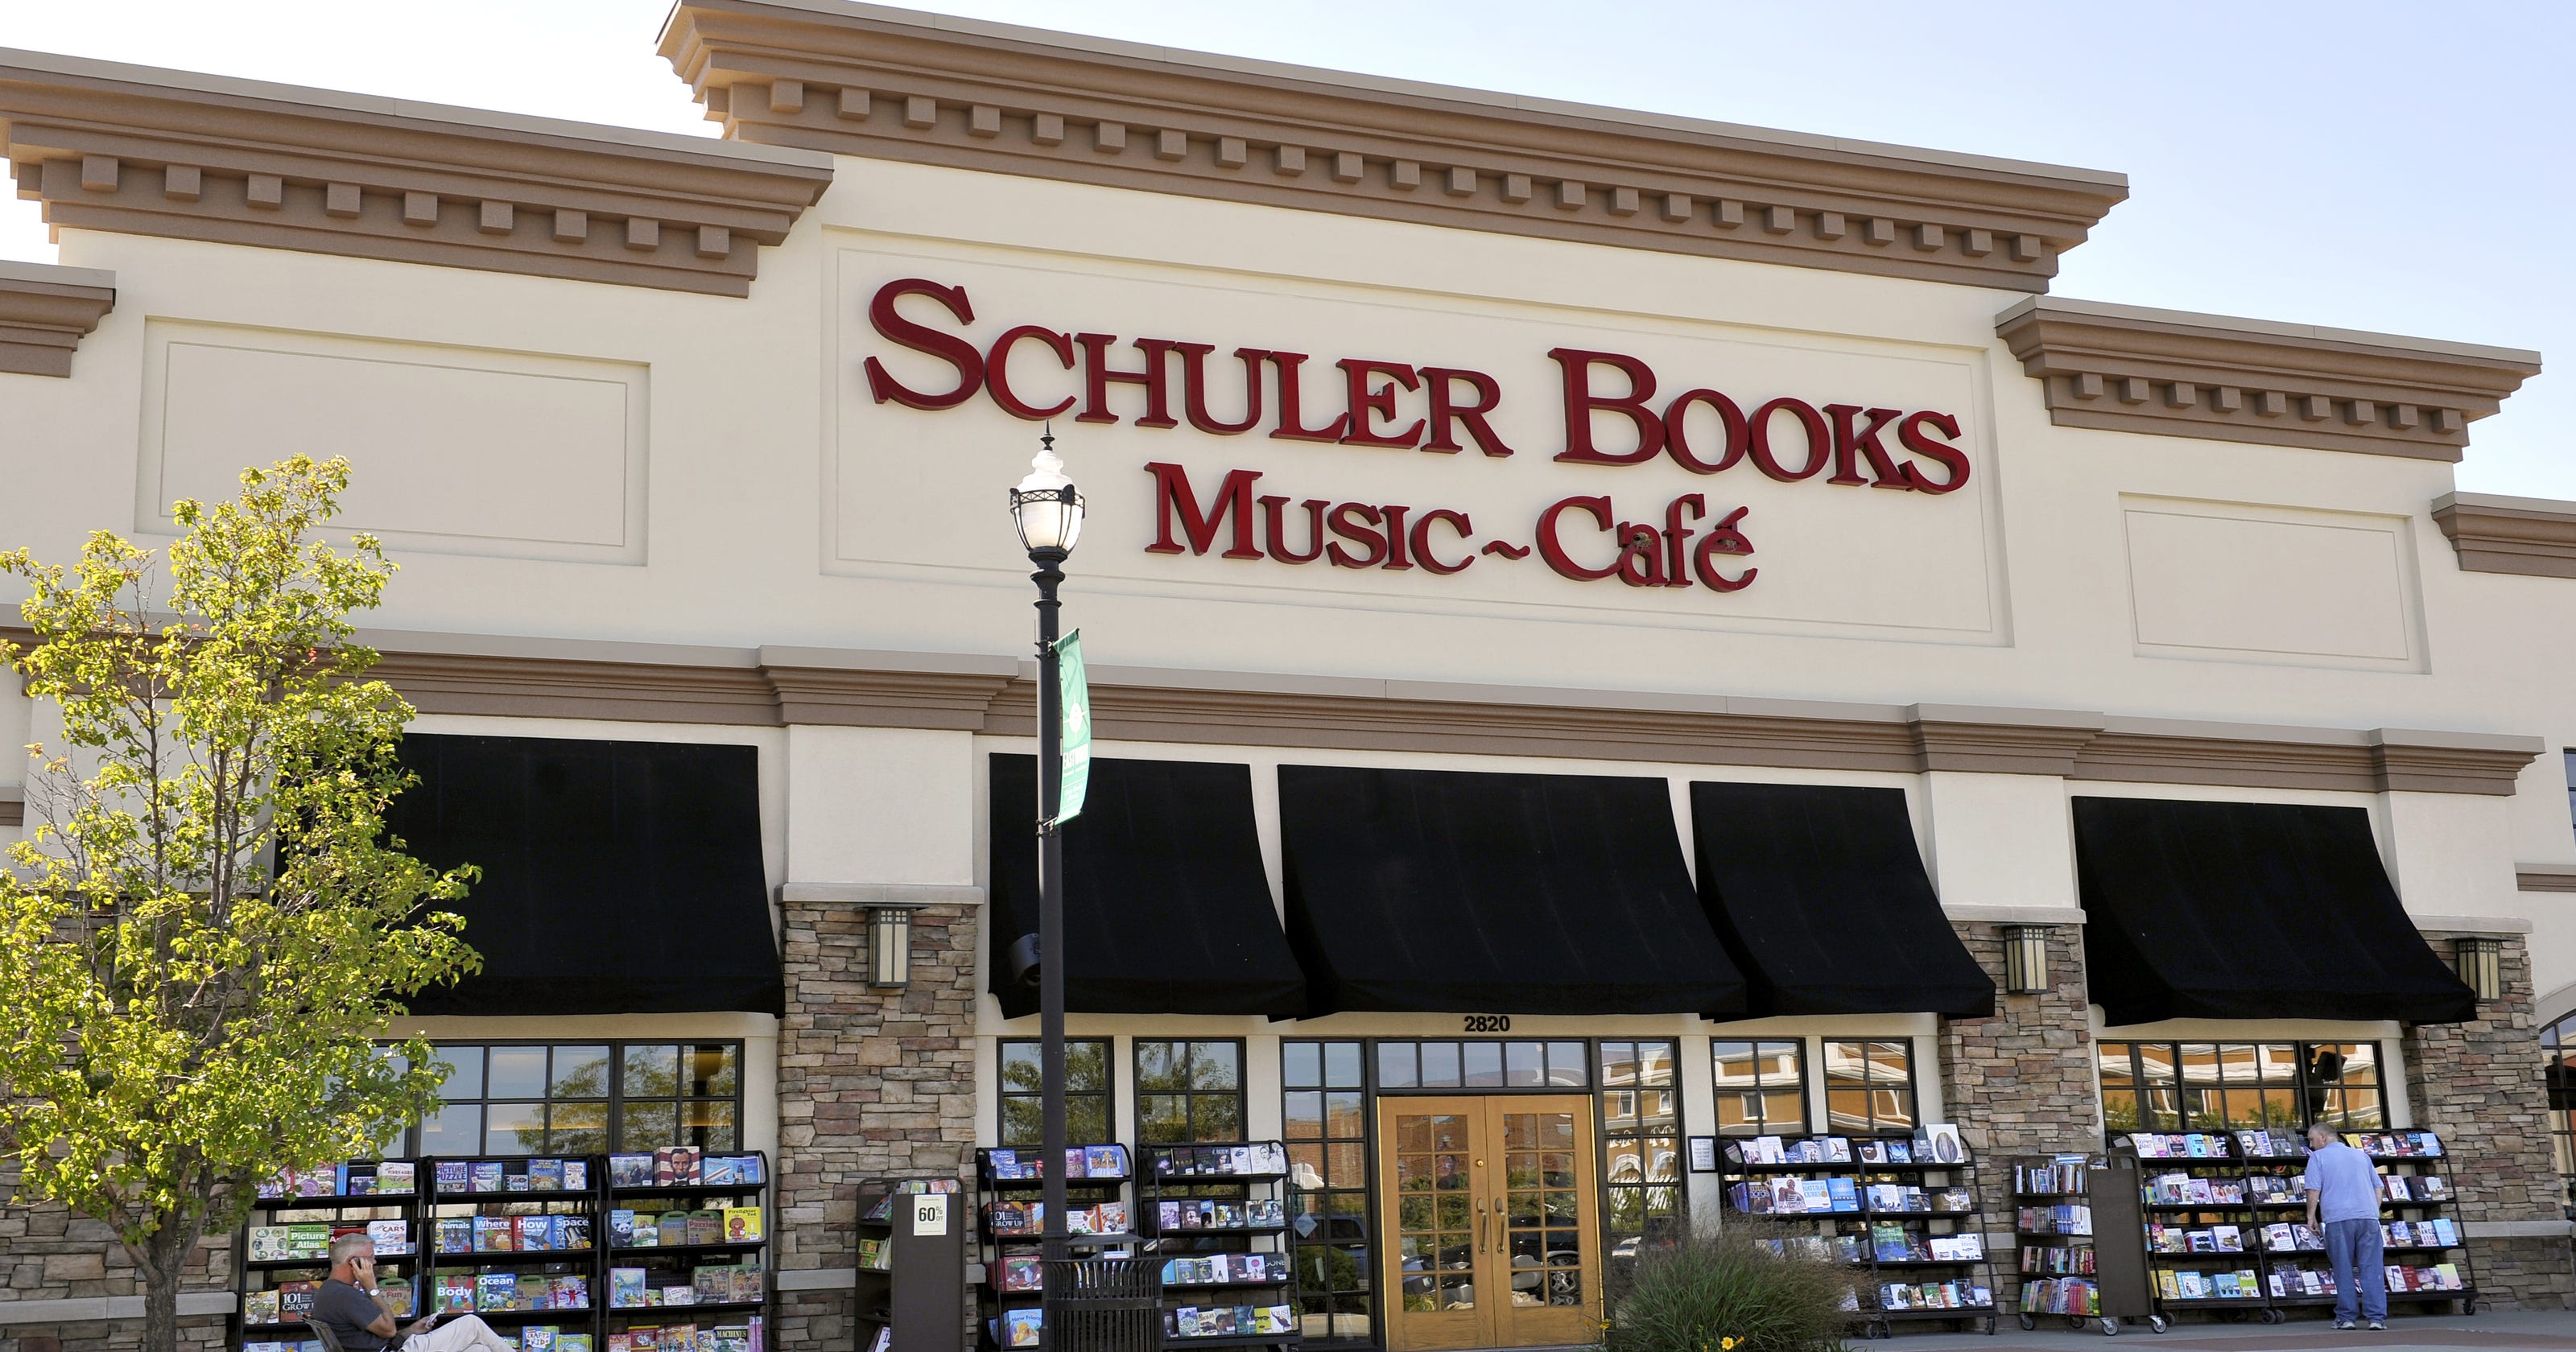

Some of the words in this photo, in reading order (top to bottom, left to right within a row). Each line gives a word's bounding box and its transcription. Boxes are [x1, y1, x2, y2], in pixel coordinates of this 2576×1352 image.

[864, 278, 1513, 458] SCHULER
[1546, 346, 1971, 494] BOOKS
[1463, 1015, 1511, 1032] 2820
[436, 1173, 466, 1181] PUZZLE
[518, 1220, 547, 1228] How
[556, 1218, 588, 1227] Space
[1014, 1219, 1023, 1227] UP
[437, 1287, 472, 1298] Body
[283, 1293, 301, 1304] 101
[283, 1303, 310, 1311] GROW
[716, 1329, 747, 1338] MACHINES
